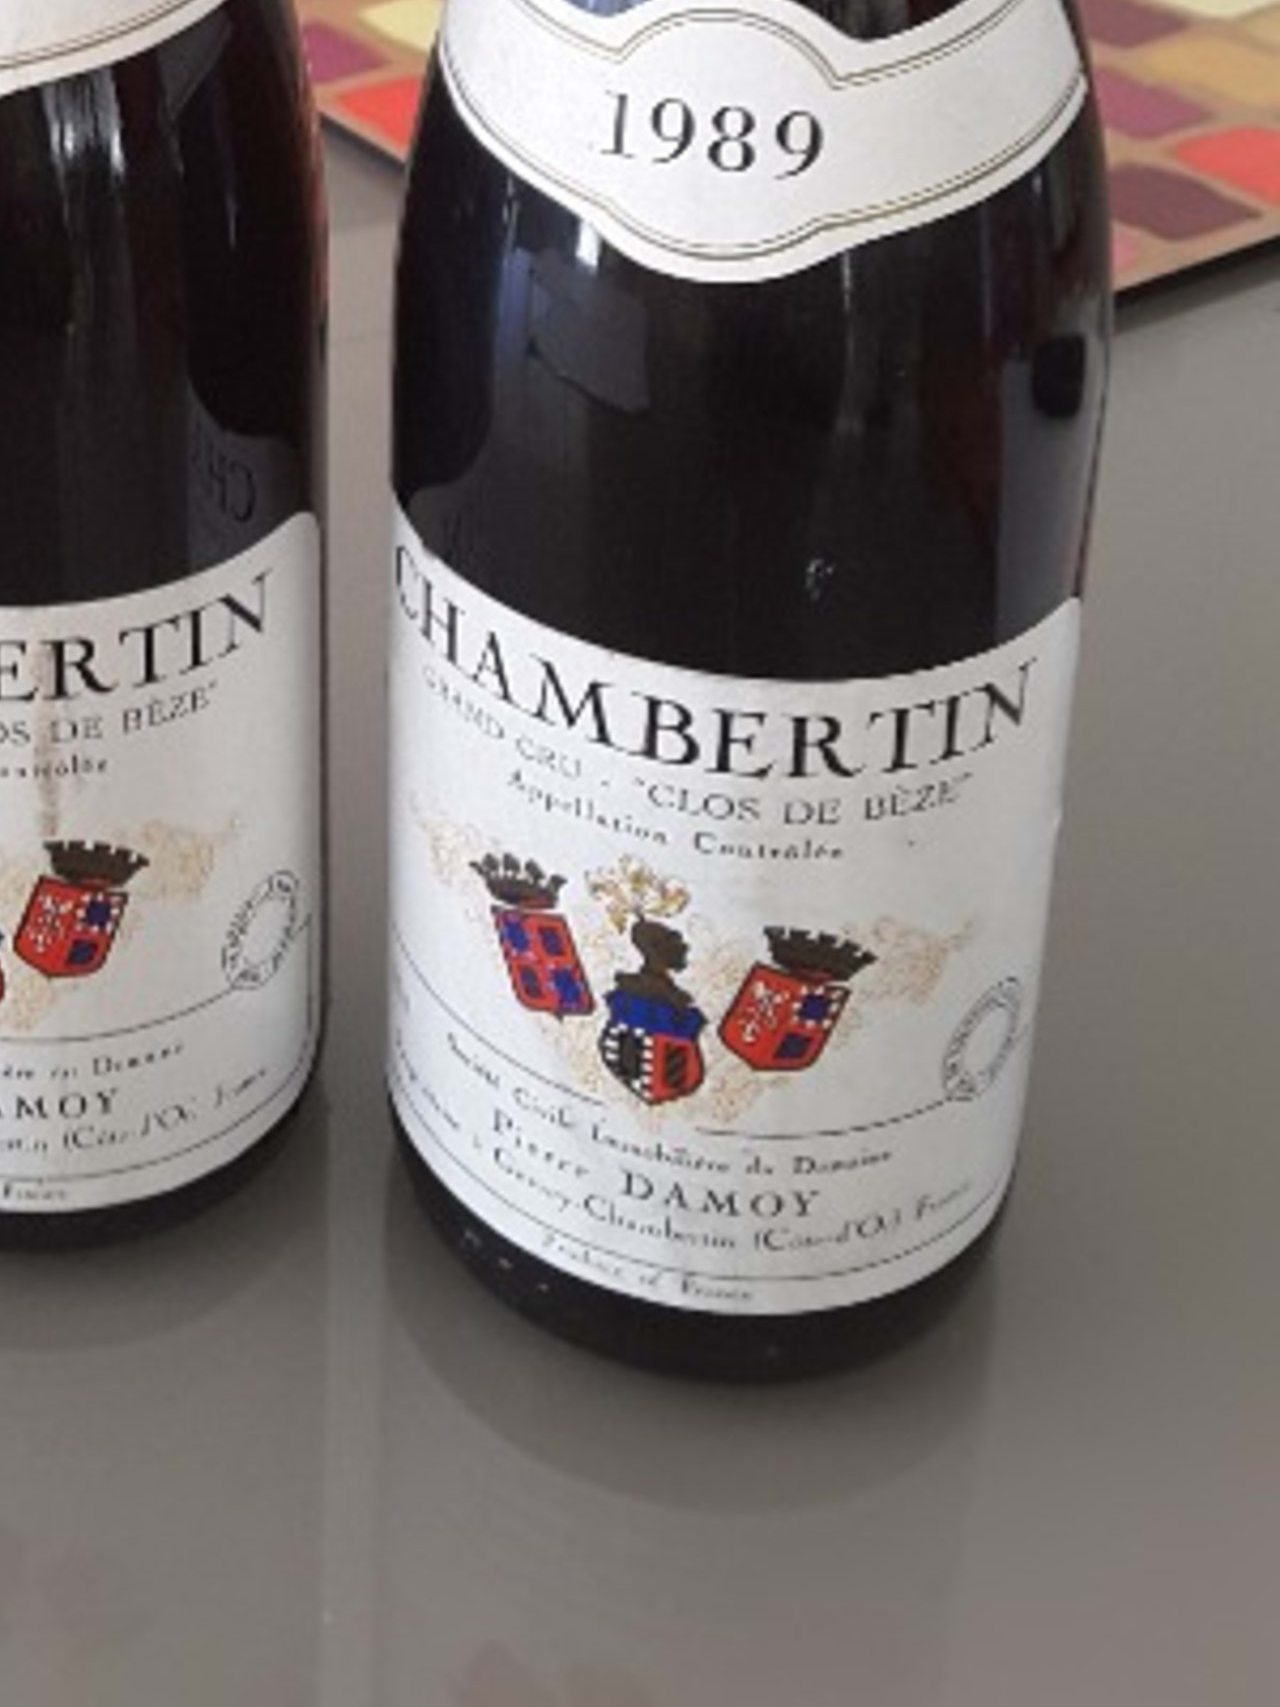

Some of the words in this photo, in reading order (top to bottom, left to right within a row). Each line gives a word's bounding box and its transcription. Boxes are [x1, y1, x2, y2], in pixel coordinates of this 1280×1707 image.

[599, 89, 824, 180] 1989
[395, 544, 1037, 780] CHAMBERTIN
[51, 716, 104, 745] DE
[783, 797, 842, 825] DE
[620, 1168, 821, 1217] DAMOY
